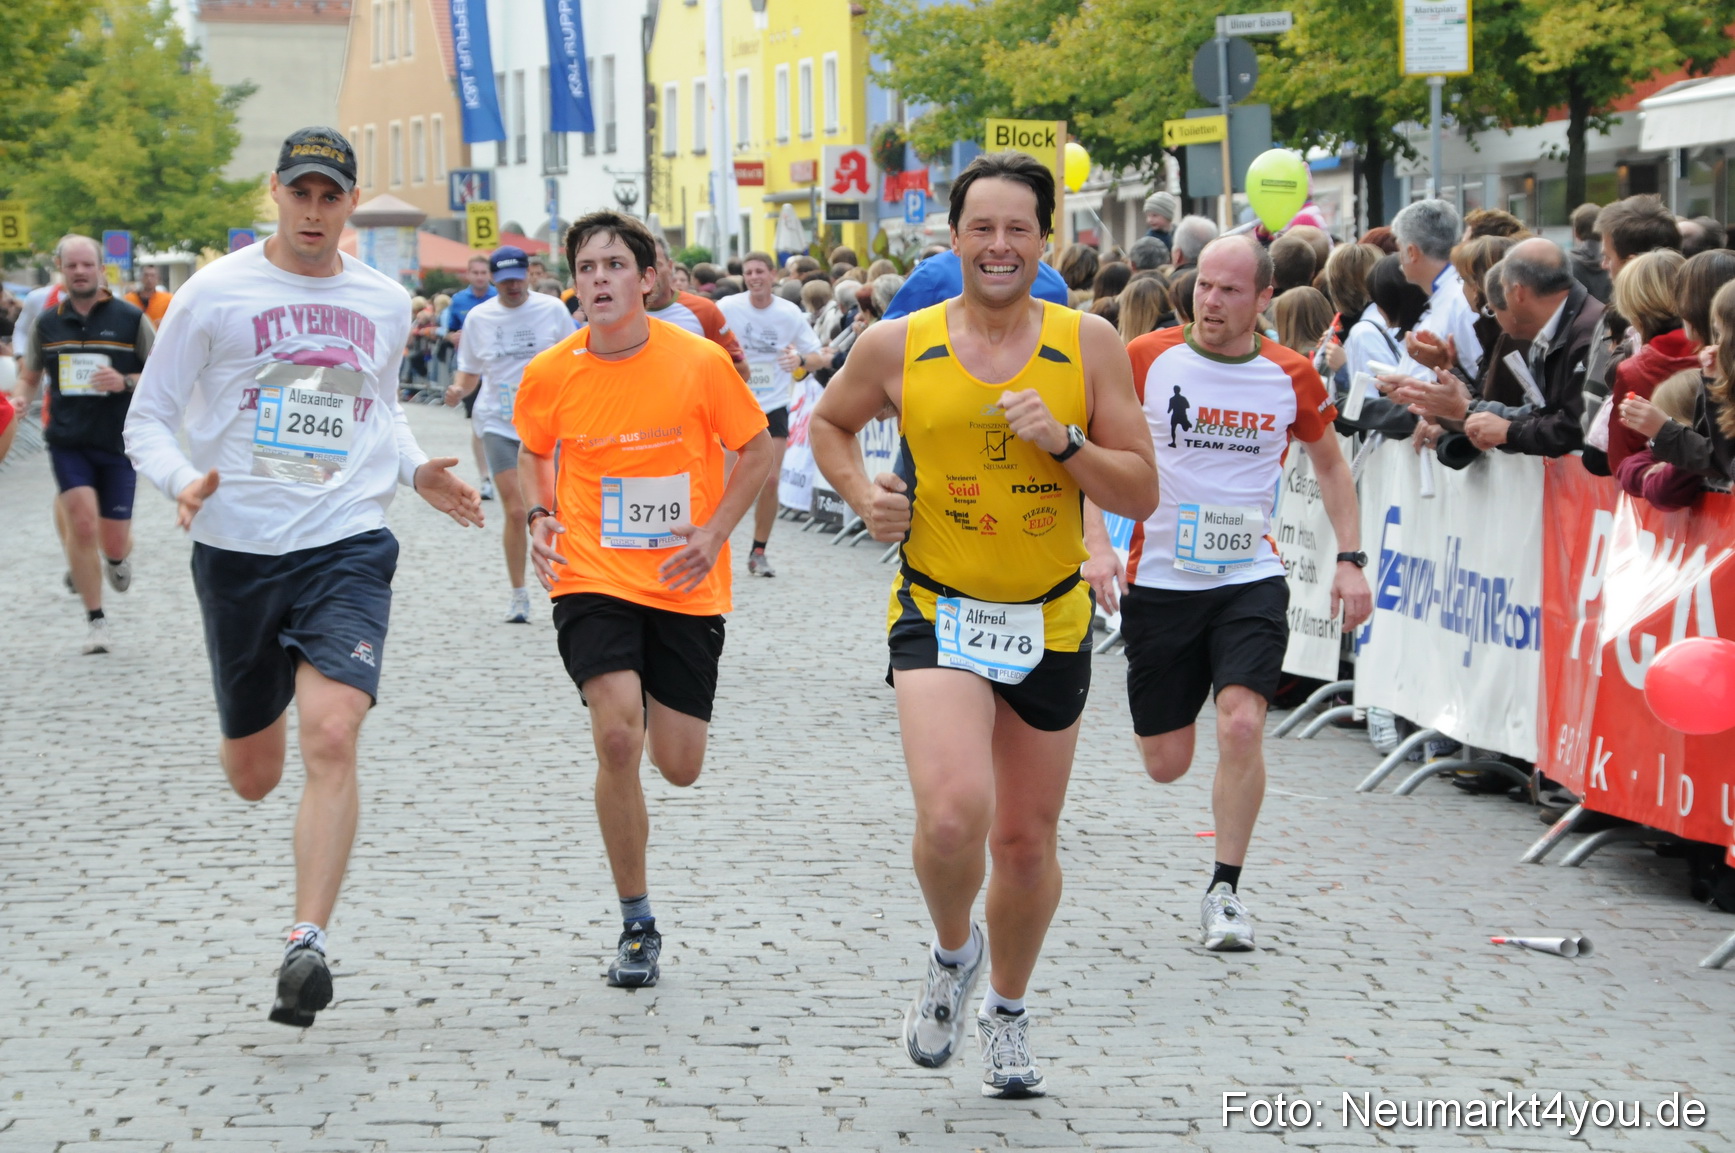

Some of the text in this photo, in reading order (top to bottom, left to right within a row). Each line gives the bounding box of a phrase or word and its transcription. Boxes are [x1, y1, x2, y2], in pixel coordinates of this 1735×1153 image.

[1260, 16, 1287, 28] Gasse
[996, 125, 1056, 147] Block
[1178, 124, 1218, 137] Toiletten
[3, 216, 18, 238] B
[476, 217, 491, 239] B
[252, 304, 376, 362] MT. VERNON
[288, 388, 344, 409] Alexander
[264, 408, 271, 418] B
[1198, 406, 1276, 431] MERZ
[286, 412, 344, 438] 2846
[1192, 418, 1259, 440] Reisen
[589, 426, 682, 448] stark ausbildung
[1184, 438, 1261, 455] TEAM 2008
[948, 482, 980, 497] Seidl
[954, 497, 977, 505] Berngau
[629, 502, 681, 523] 3719
[1022, 507, 1057, 522] PIZZERIA
[1204, 511, 1244, 526] Michael
[1029, 515, 1054, 529] ELIO
[1182, 529, 1189, 538] A
[1203, 532, 1252, 551] 3063
[944, 620, 951, 630] A
[966, 608, 1006, 625] Alfred
[968, 628, 1033, 655] 2178
